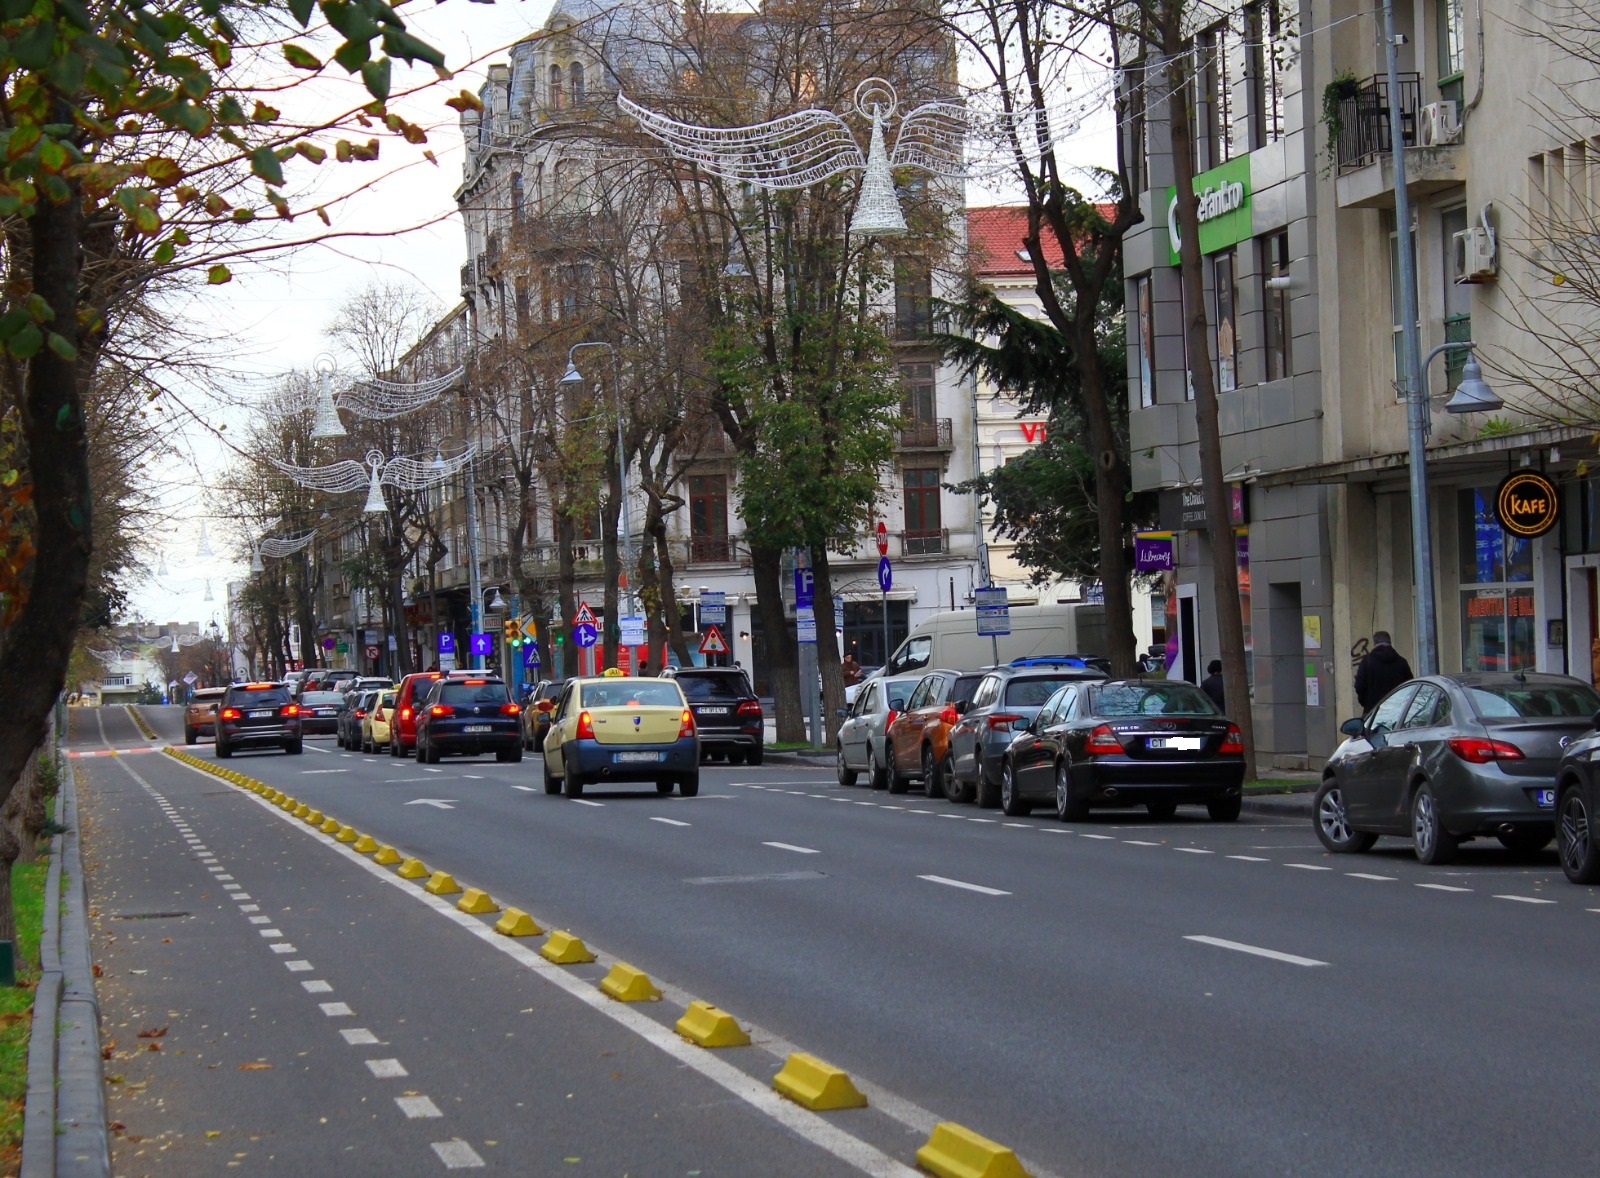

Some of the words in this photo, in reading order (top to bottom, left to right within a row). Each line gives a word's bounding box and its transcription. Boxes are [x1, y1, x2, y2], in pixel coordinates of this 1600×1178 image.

[1140, 549, 1171, 567] Library
[1151, 738, 1164, 748] CT
[1546, 791, 1554, 803] C
